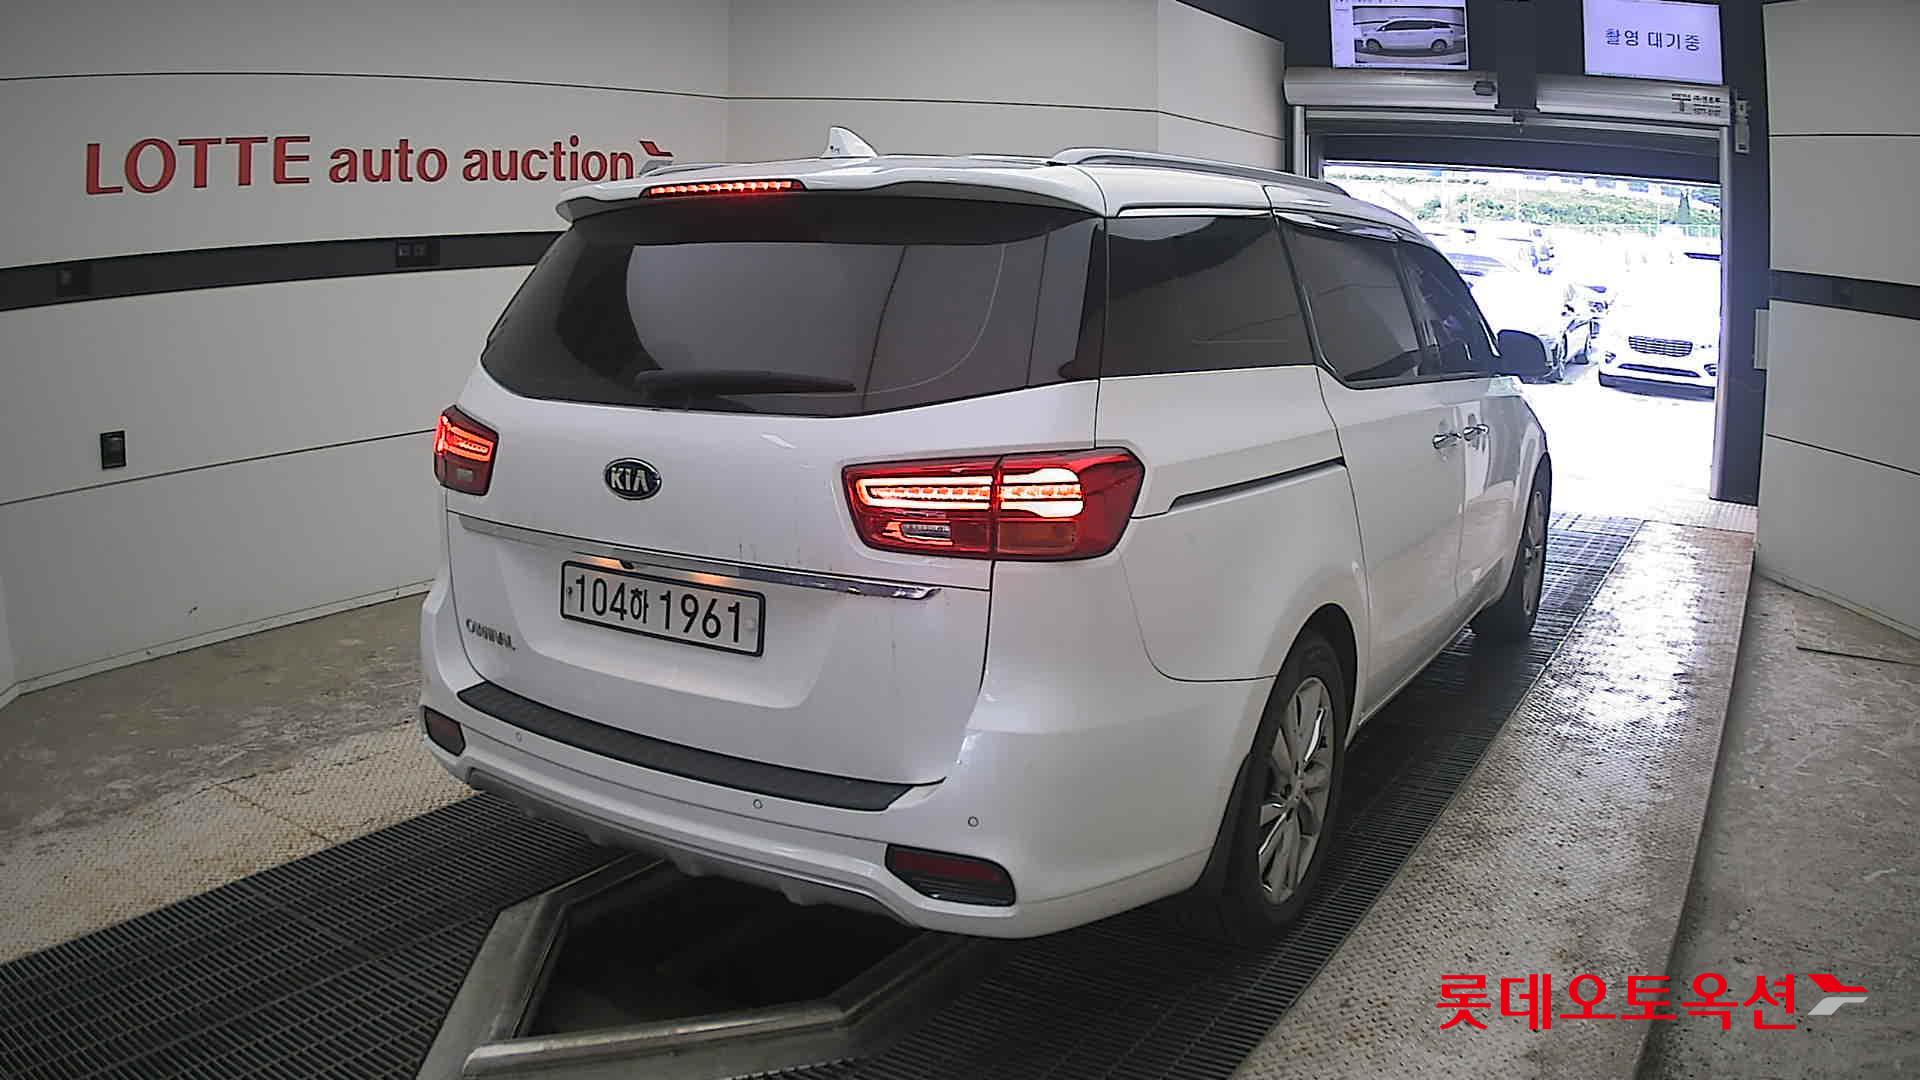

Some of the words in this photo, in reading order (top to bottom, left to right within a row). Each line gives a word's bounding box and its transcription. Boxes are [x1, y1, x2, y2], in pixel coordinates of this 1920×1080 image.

[1605, 28, 1639, 46] 촬영
[1647, 31, 1700, 51] 대기중
[86, 136, 310, 194] LOTTE
[329, 138, 447, 184] auto
[463, 136, 634, 182] auction
[609, 467, 649, 492] KIA
[575, 574, 649, 624] 104하
[660, 590, 740, 643] 1961
